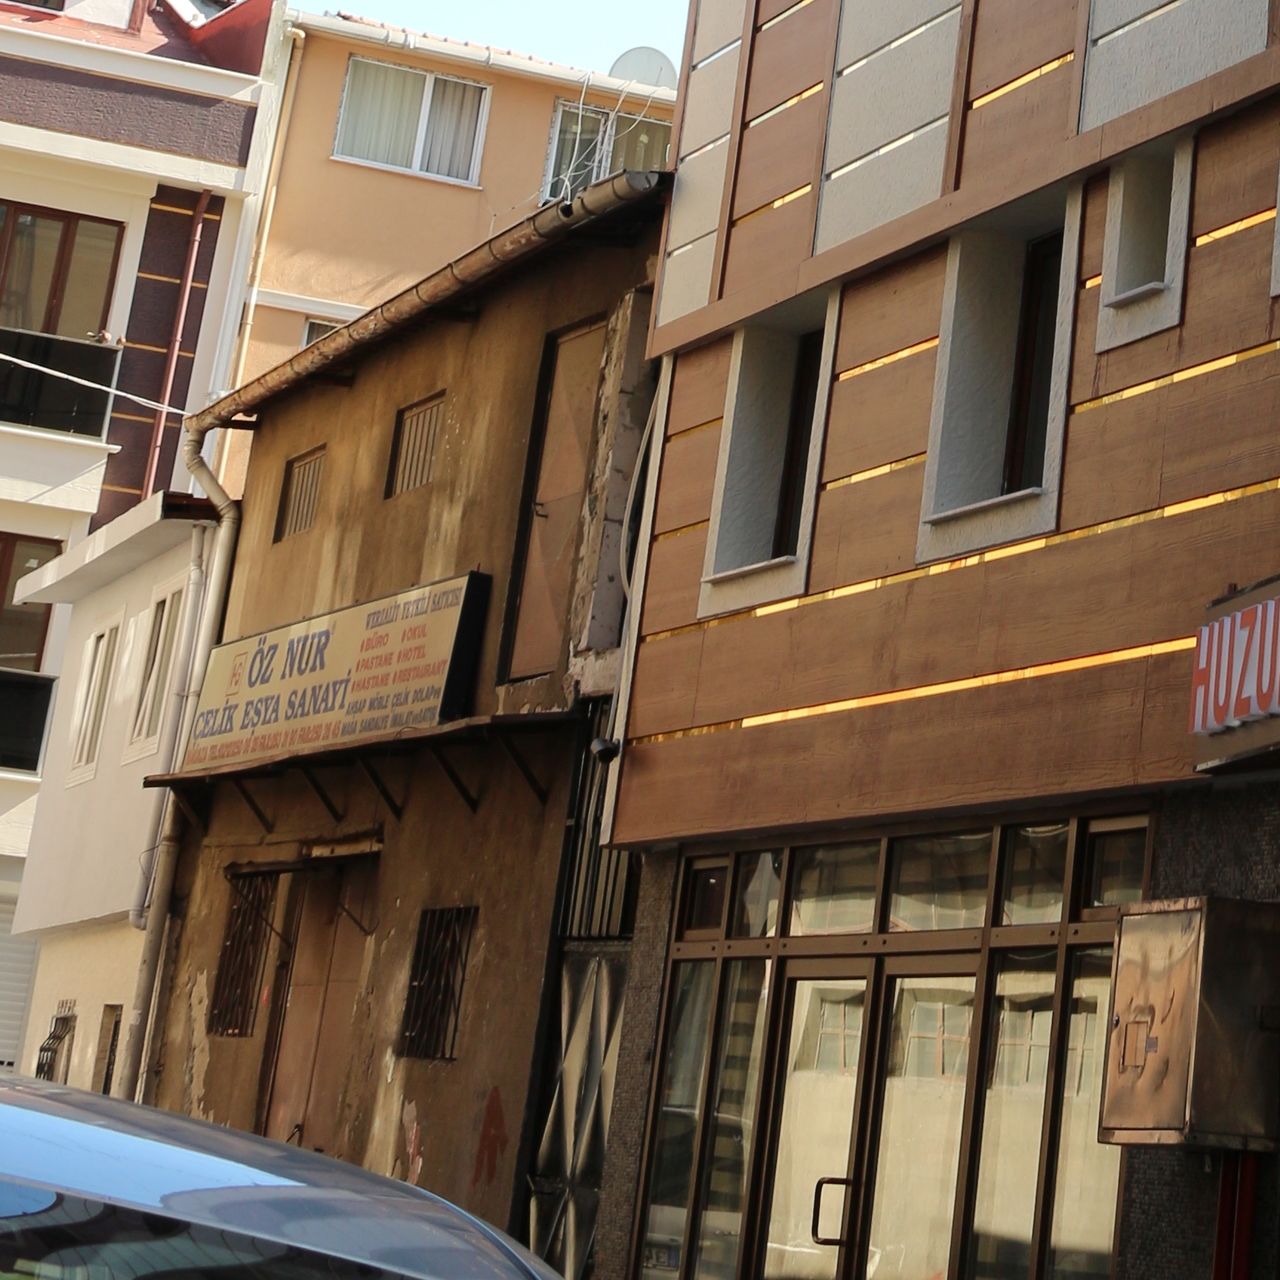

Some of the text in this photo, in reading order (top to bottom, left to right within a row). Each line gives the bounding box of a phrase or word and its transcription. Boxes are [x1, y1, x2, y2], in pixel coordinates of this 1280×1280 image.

[365, 623, 428, 649] BÜRO OKUL
[247, 629, 331, 688] ÖZ NUR
[359, 644, 426, 671] PASTANE HOTEL
[354, 673, 390, 691] HASTANE
[240, 694, 282, 736] EŞYA
[284, 669, 352, 721] SANAYİ
